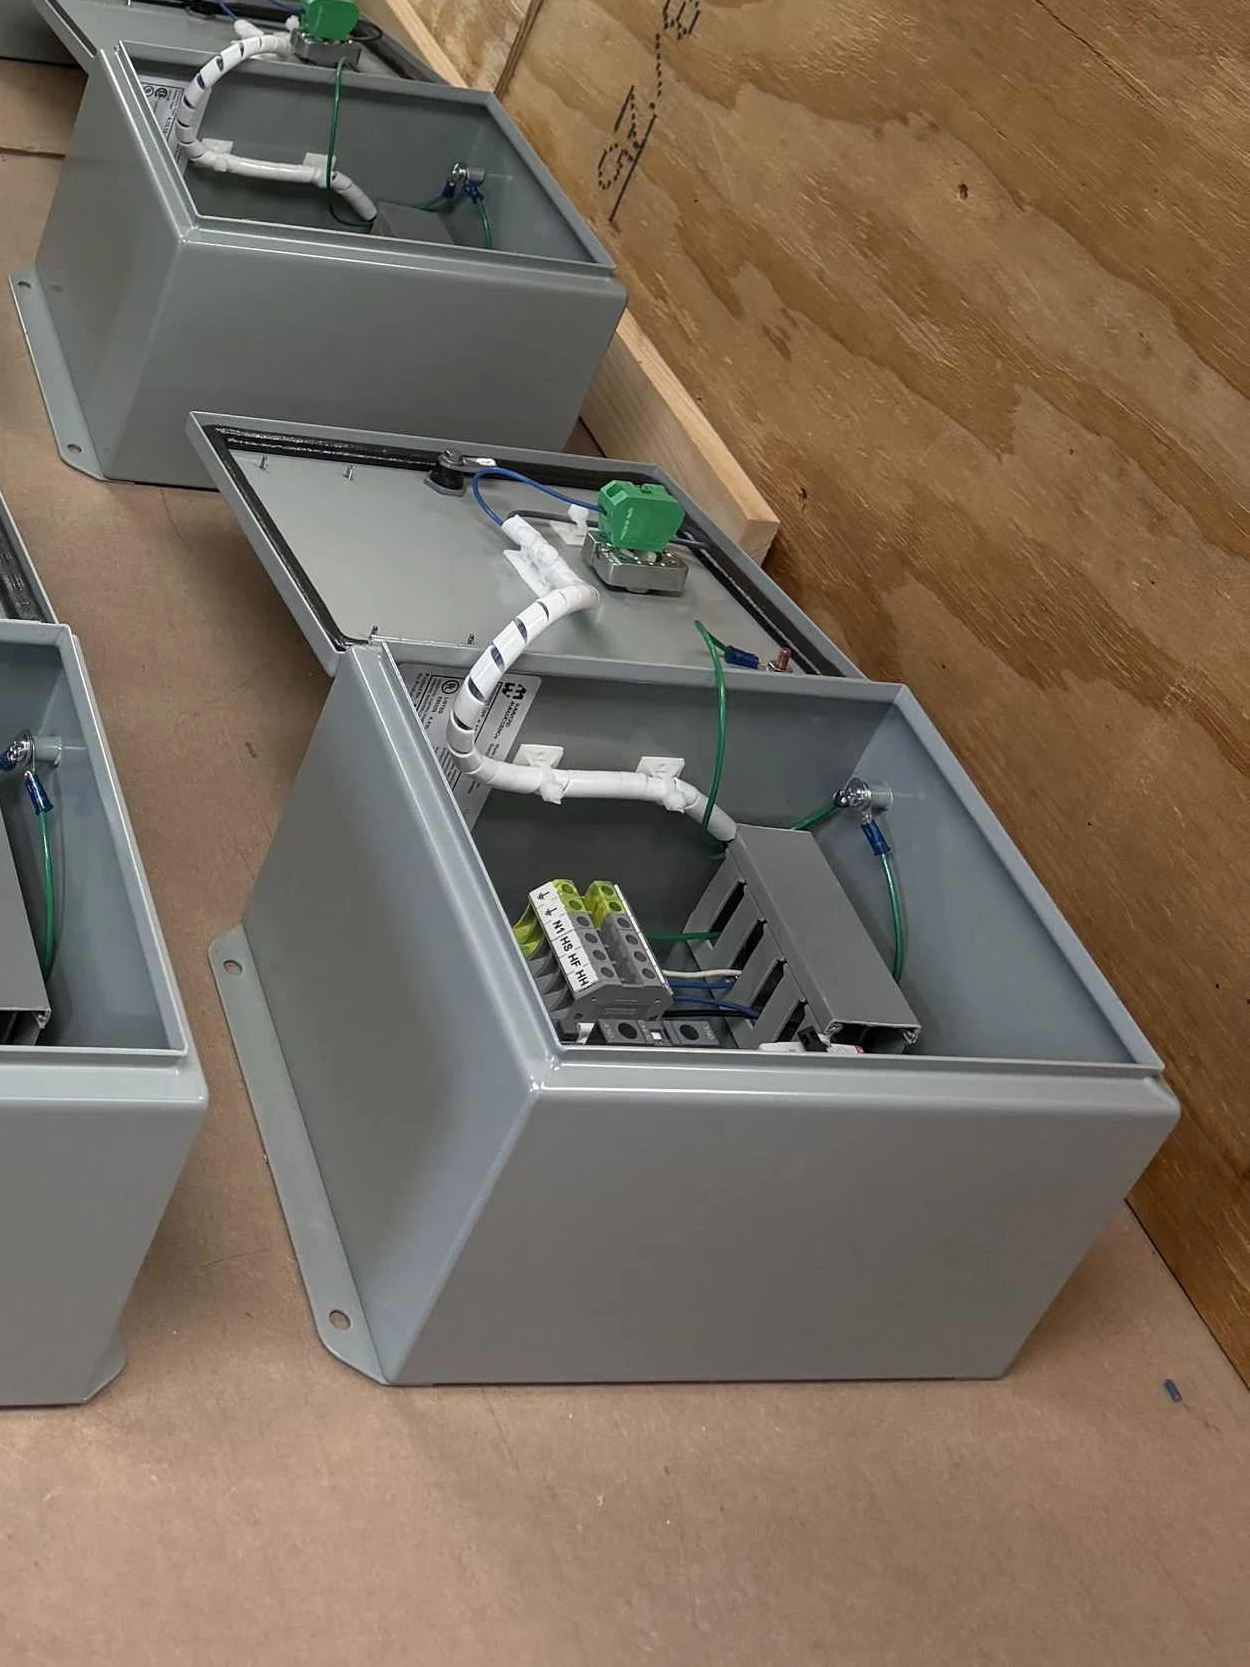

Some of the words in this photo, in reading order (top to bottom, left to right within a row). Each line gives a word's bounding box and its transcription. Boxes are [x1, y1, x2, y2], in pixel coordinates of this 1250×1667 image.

[552, 919, 565, 935] N1
[560, 935, 573, 952] HS
[568, 953, 581, 969] HF
[575, 968, 589, 987] HH
